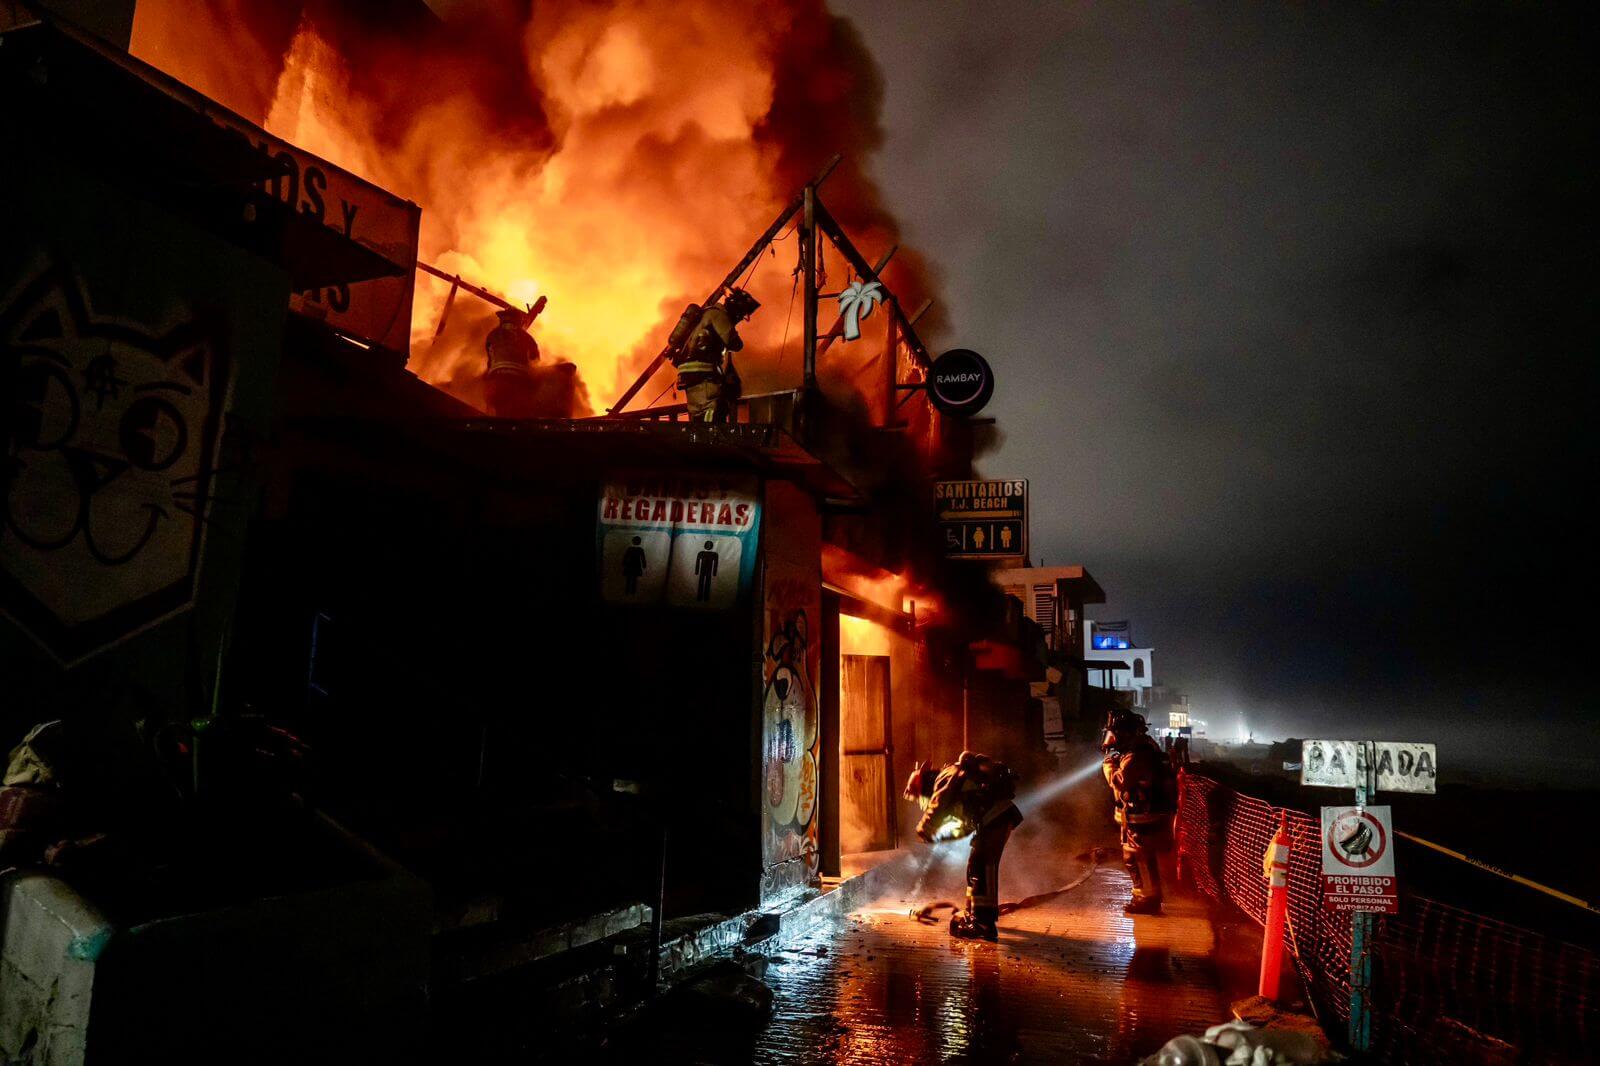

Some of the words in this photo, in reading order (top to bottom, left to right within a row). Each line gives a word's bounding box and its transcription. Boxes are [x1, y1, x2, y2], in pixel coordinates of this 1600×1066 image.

[936, 373, 981, 384] RAMBAY
[936, 482, 1023, 499] SANITARIOS
[973, 497, 1008, 509] BEACH
[604, 496, 749, 526] REGADERAS
[1327, 876, 1391, 886] PROHIBIDO
[1335, 885, 1349, 894] EL
[1353, 885, 1383, 895] PASO
[1351, 897, 1393, 905] PERSONAL
